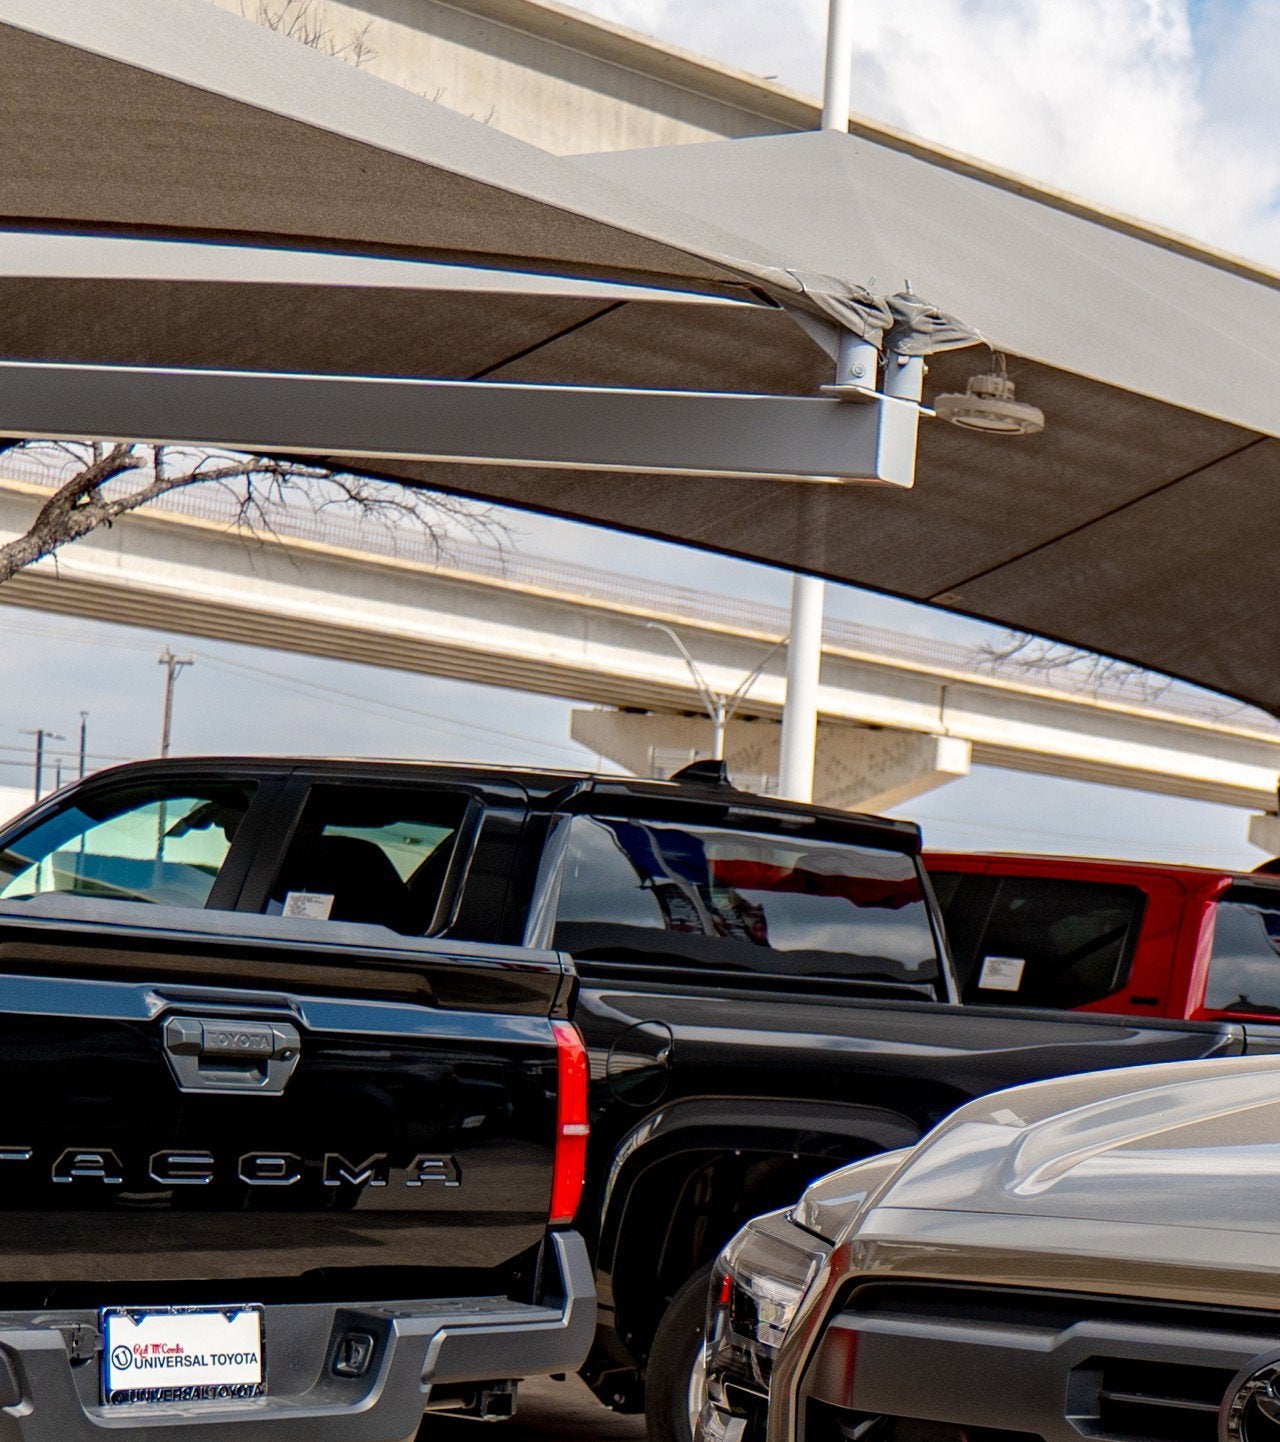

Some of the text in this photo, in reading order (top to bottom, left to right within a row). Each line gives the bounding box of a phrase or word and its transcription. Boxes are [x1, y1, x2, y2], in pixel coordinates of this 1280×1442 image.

[207, 1031, 271, 1049] TOYOTA
[133, 1343, 148, 1359] Red
[134, 1352, 258, 1369] UNIVERSAL TOYOTA
[129, 1384, 264, 1402] UNIVERSAL TOYOTA
